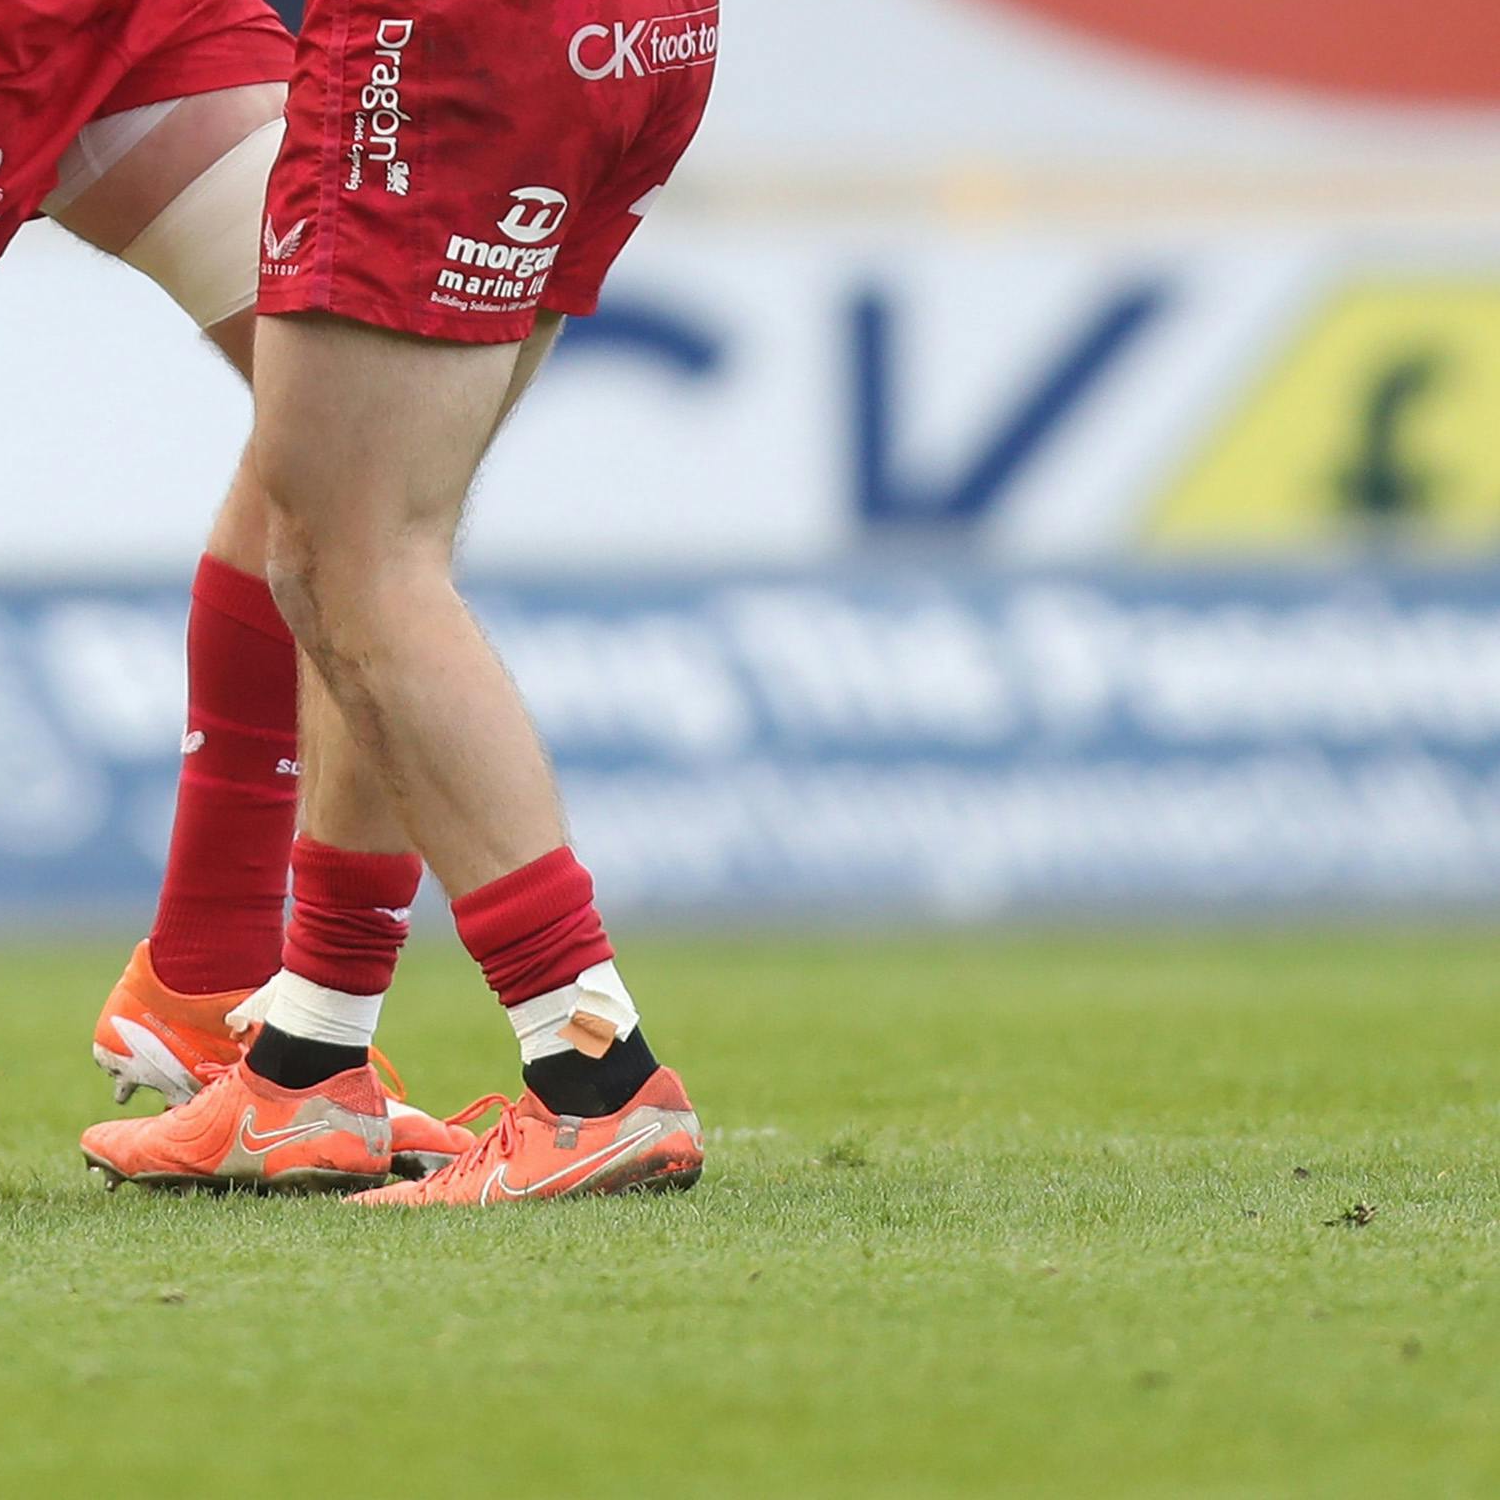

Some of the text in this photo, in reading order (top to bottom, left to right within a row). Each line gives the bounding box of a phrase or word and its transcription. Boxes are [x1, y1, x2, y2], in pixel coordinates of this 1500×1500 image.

[568, 19, 646, 81] CK
[361, 19, 414, 161] Dragon
[437, 268, 524, 298] marine
